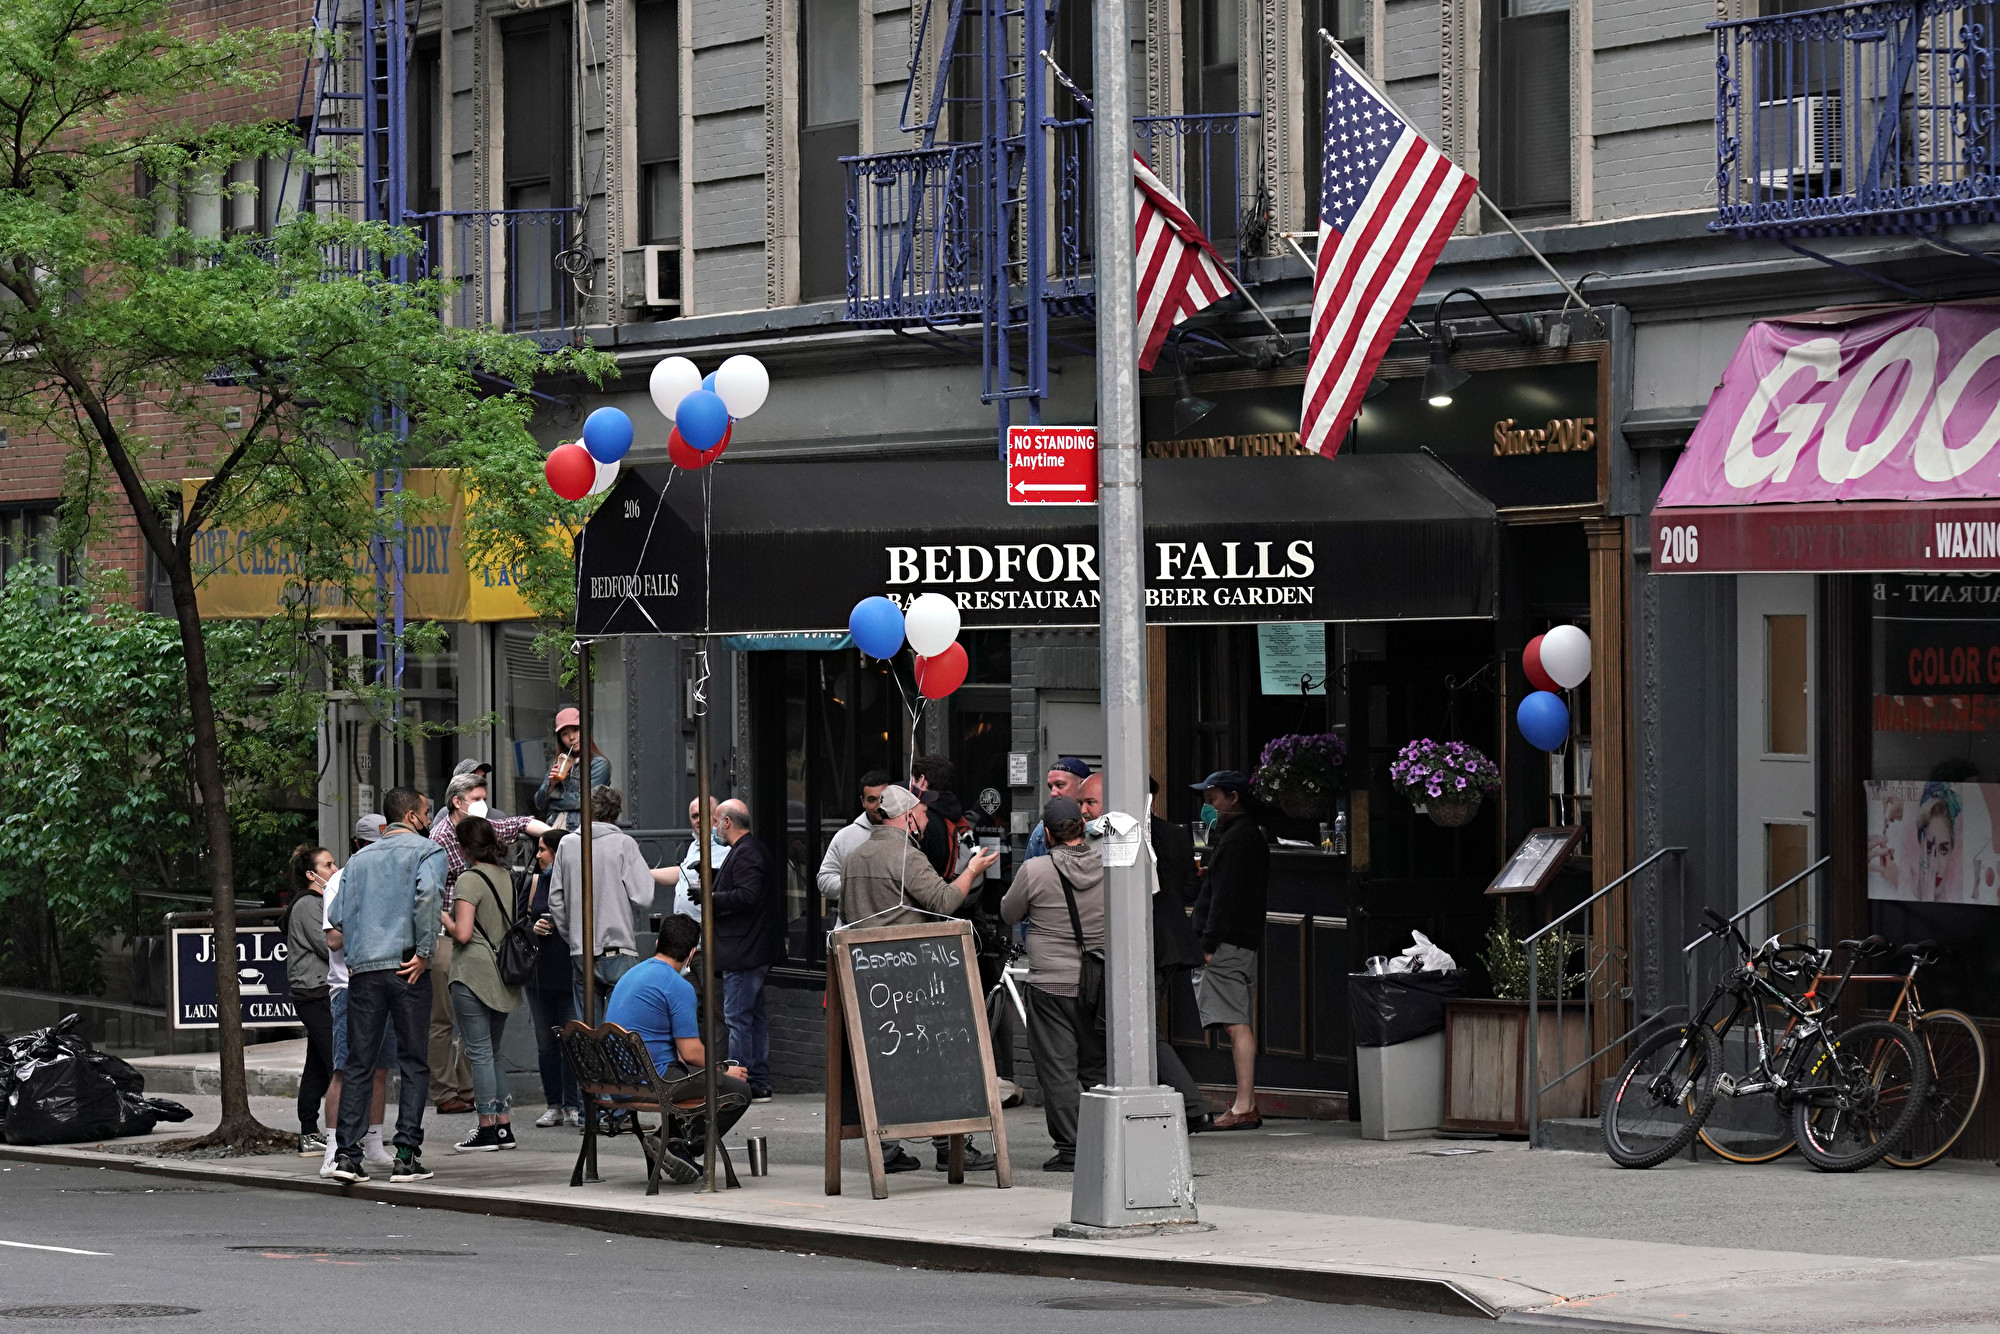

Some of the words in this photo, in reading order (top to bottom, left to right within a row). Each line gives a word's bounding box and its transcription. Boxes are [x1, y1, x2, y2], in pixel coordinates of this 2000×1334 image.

[1014, 435, 1031, 450] NO
[1034, 435, 1095, 450] STANDING
[1493, 418, 1546, 456] Since
[1547, 417, 1595, 453] 2015
[1014, 453, 1065, 470] Anytime
[624, 499, 641, 519] 206
[195, 529, 228, 575] DRY
[1660, 525, 1699, 564] 206
[885, 543, 1101, 585] BEDFOR
[1155, 540, 1315, 580] FALLS
[591, 573, 642, 599] BEDFORD
[644, 573, 679, 597] FALLS
[956, 589, 1101, 610] RESTAURAN
[1145, 588, 1210, 607] BEER
[1213, 586, 1315, 606] GARDEN
[1909, 646, 1981, 686] COLOR
